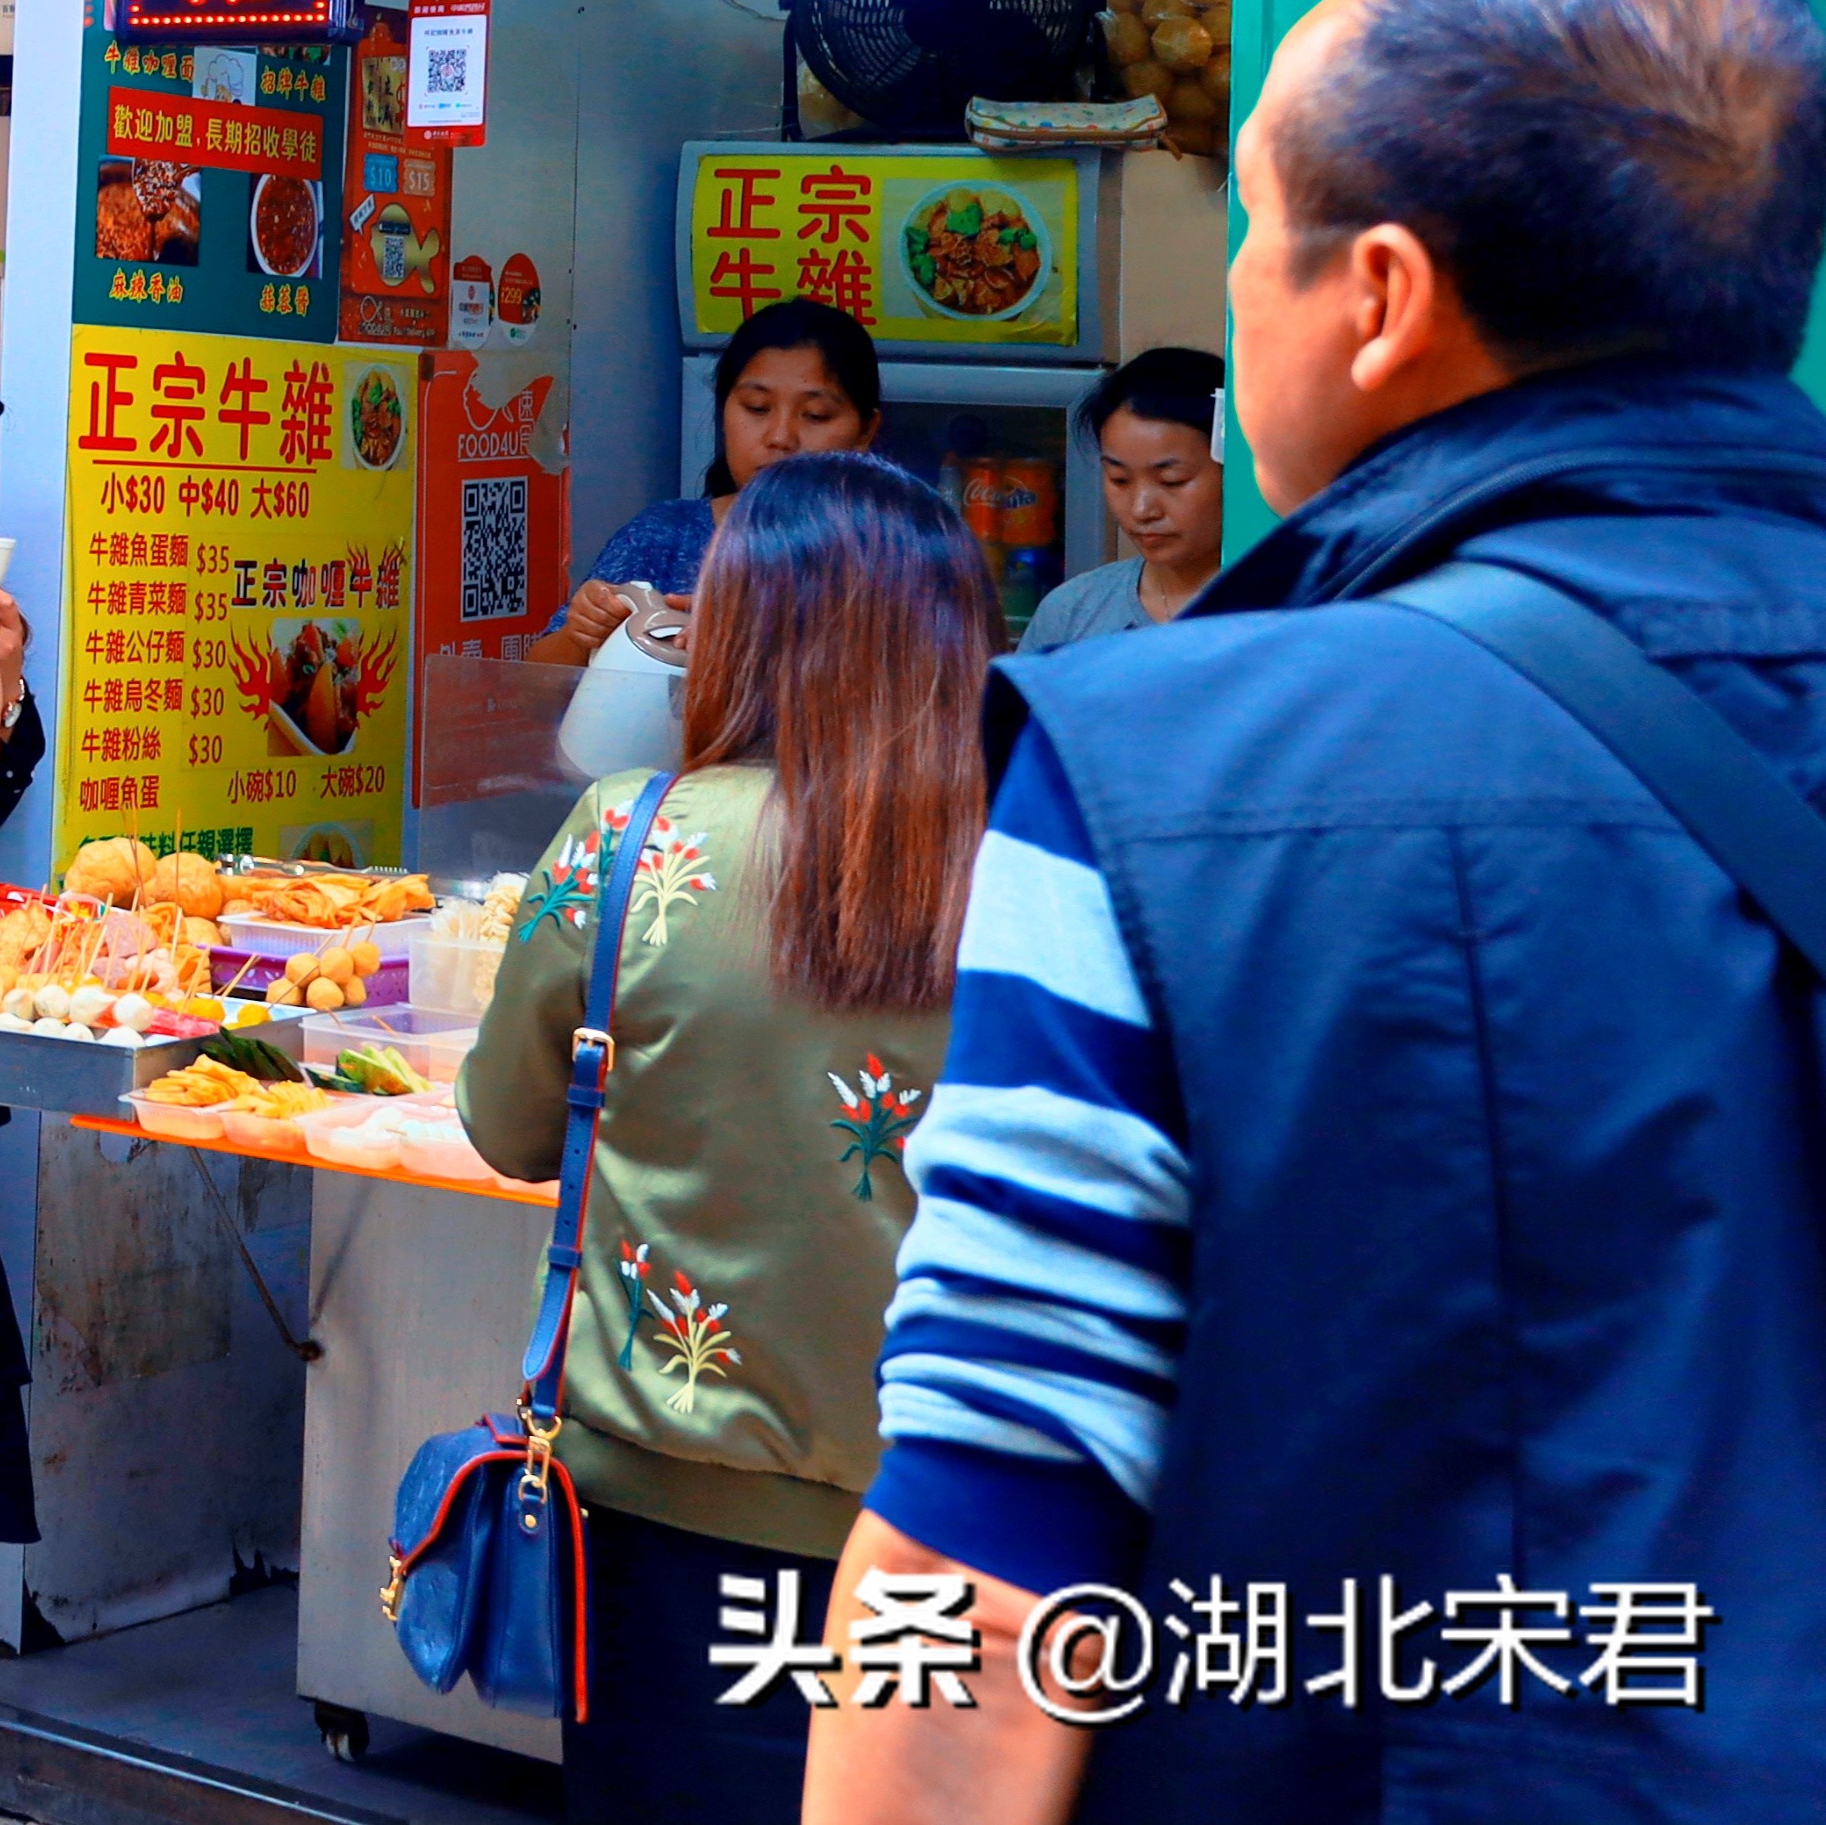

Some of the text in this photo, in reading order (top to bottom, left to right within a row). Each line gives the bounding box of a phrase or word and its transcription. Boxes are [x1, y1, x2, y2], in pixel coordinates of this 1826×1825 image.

[370, 167, 430, 190] $10 $15
[706, 165, 871, 243] 正宗
[709, 247, 876, 325] 牛雜
[79, 351, 334, 465] 正宗牛雜
[458, 433, 519, 458] FOOD4U
[101, 472, 309, 519] 小$30 中$40 大$60
[196, 542, 229, 575] $35
[195, 592, 227, 623] $35
[193, 640, 226, 671] $30
[191, 688, 224, 718] $30
[82, 726, 222, 766] 牛雜粉絲 $30
[228, 770, 296, 804] 小碗$10
[320, 765, 385, 799] 大碗$20
